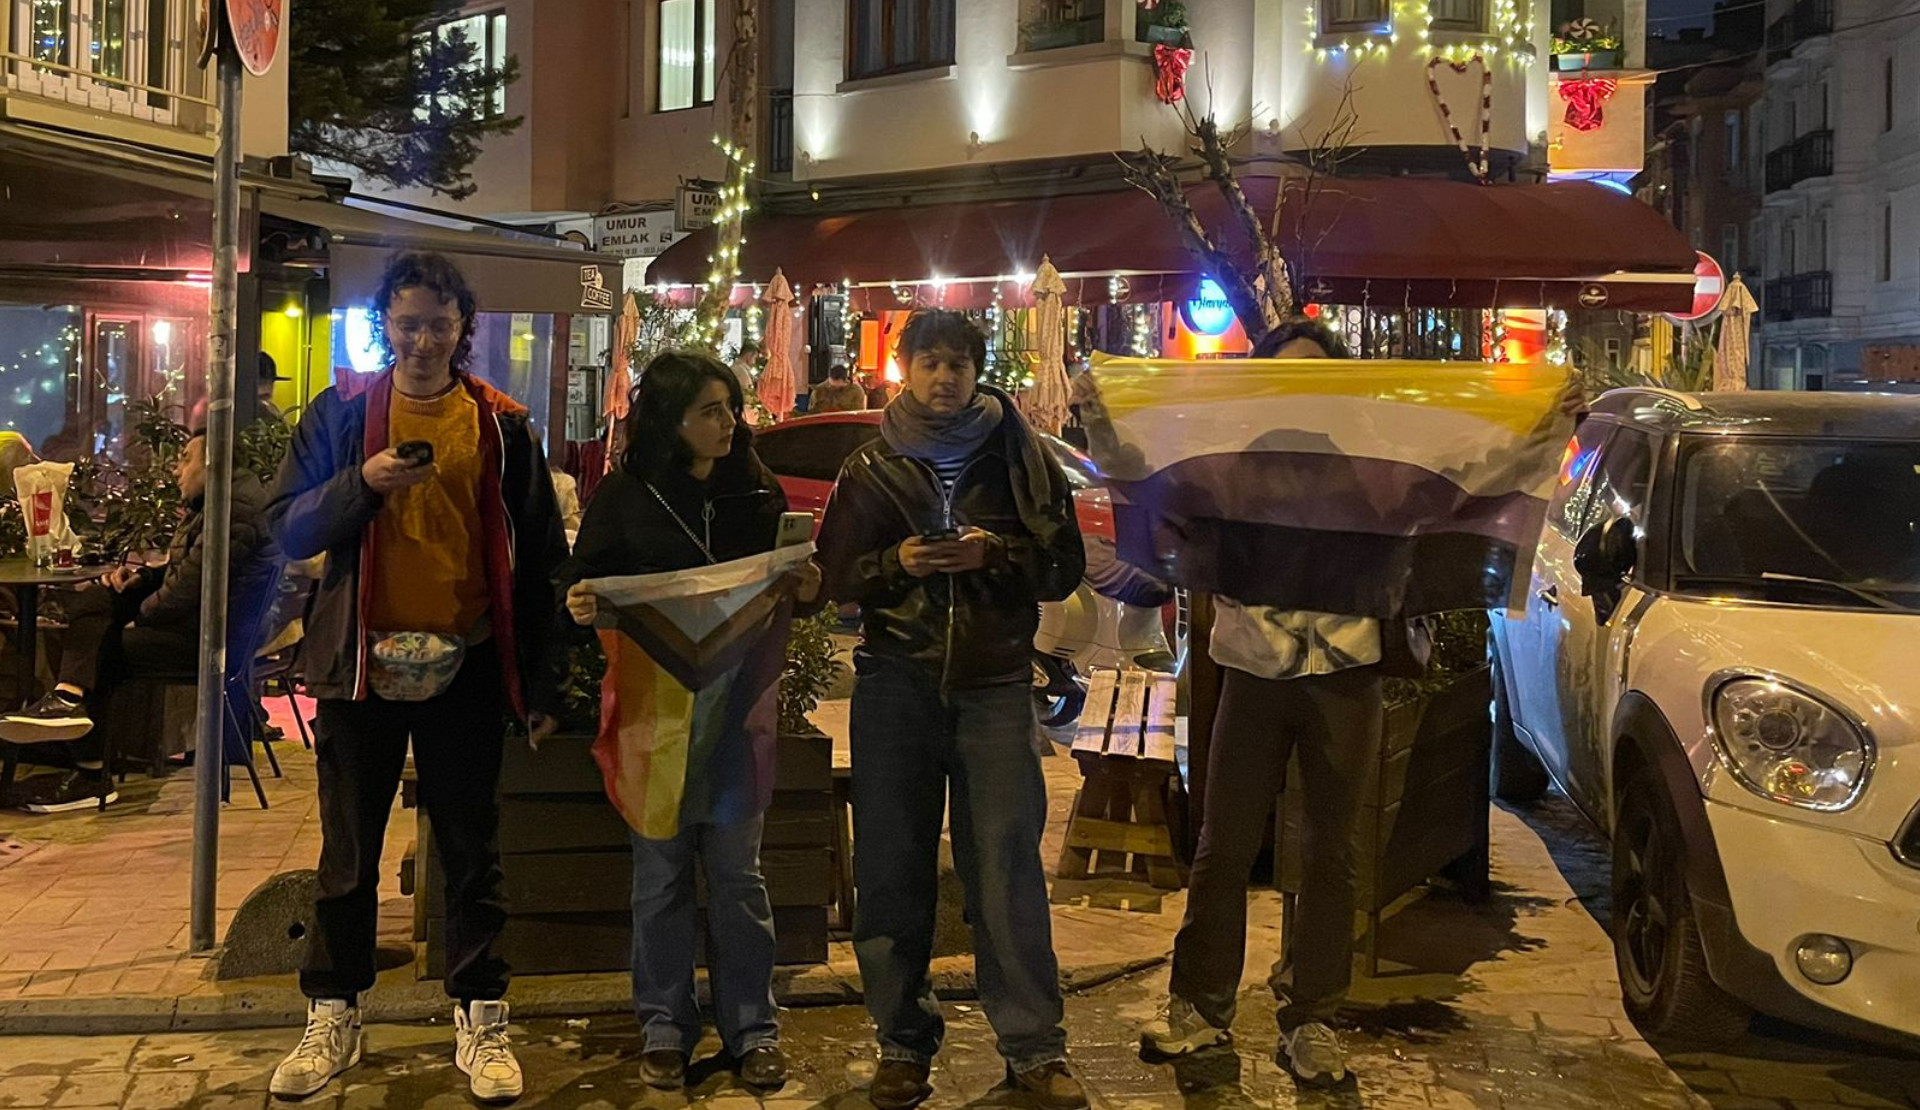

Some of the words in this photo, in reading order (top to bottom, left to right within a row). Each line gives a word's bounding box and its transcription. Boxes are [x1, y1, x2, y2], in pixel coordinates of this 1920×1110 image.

[606, 217, 647, 230] UMUR
[602, 233, 650, 246] EMLAK
[584, 269, 595, 281] TEA
[587, 287, 611, 305] COFFEE
